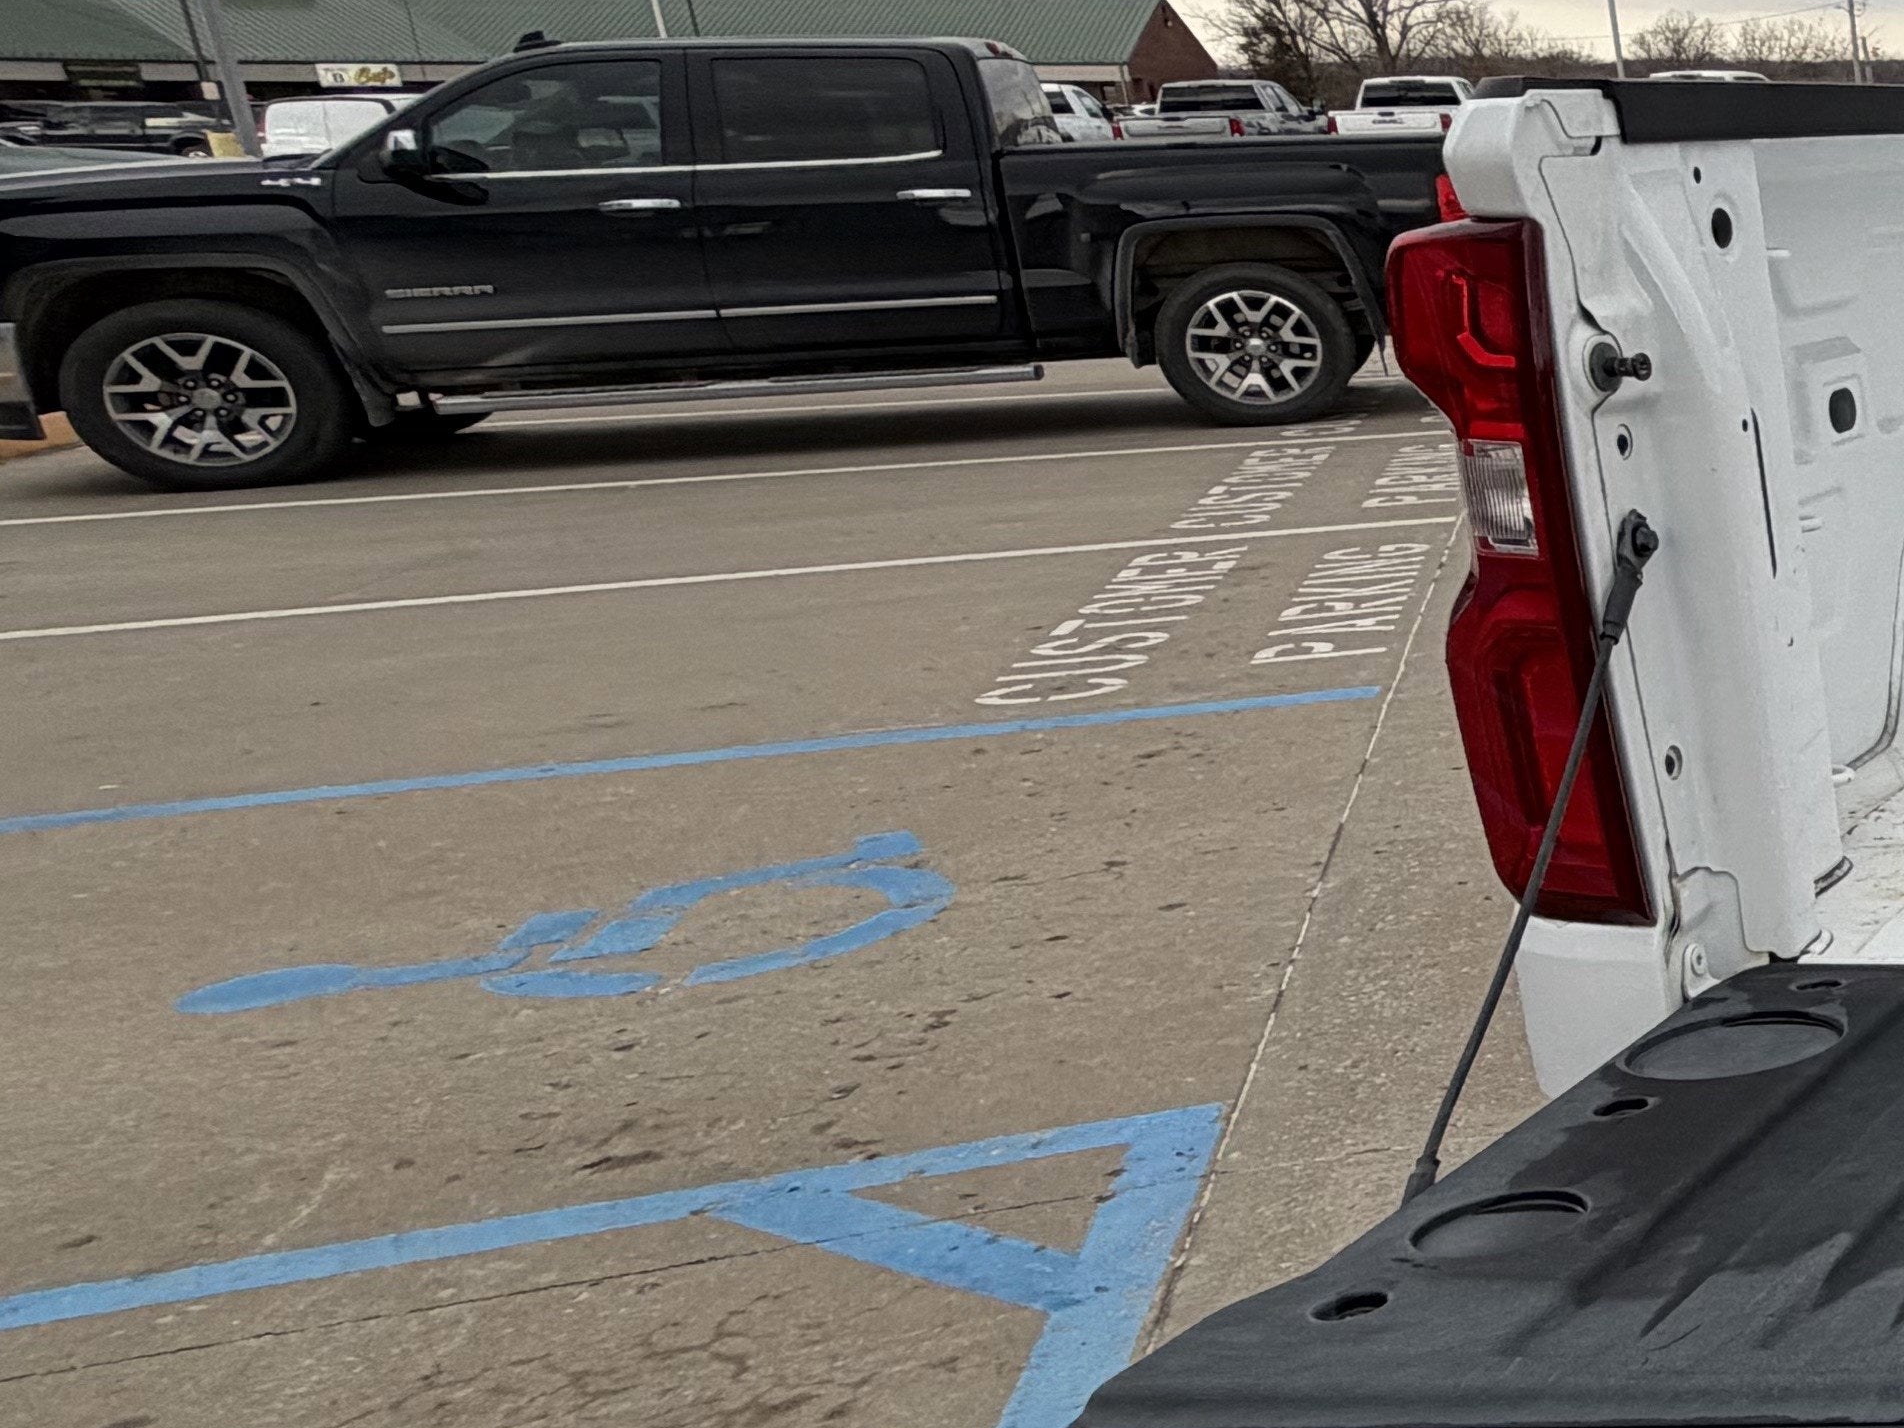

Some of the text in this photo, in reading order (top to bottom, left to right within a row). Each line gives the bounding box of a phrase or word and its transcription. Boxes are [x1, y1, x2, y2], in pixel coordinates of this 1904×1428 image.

[384, 284, 494, 299] SIERRA
[1171, 445, 1335, 530] CUSTOMER
[975, 544, 1249, 706] CUSTOMER
[1250, 543, 1432, 665] PARKING
